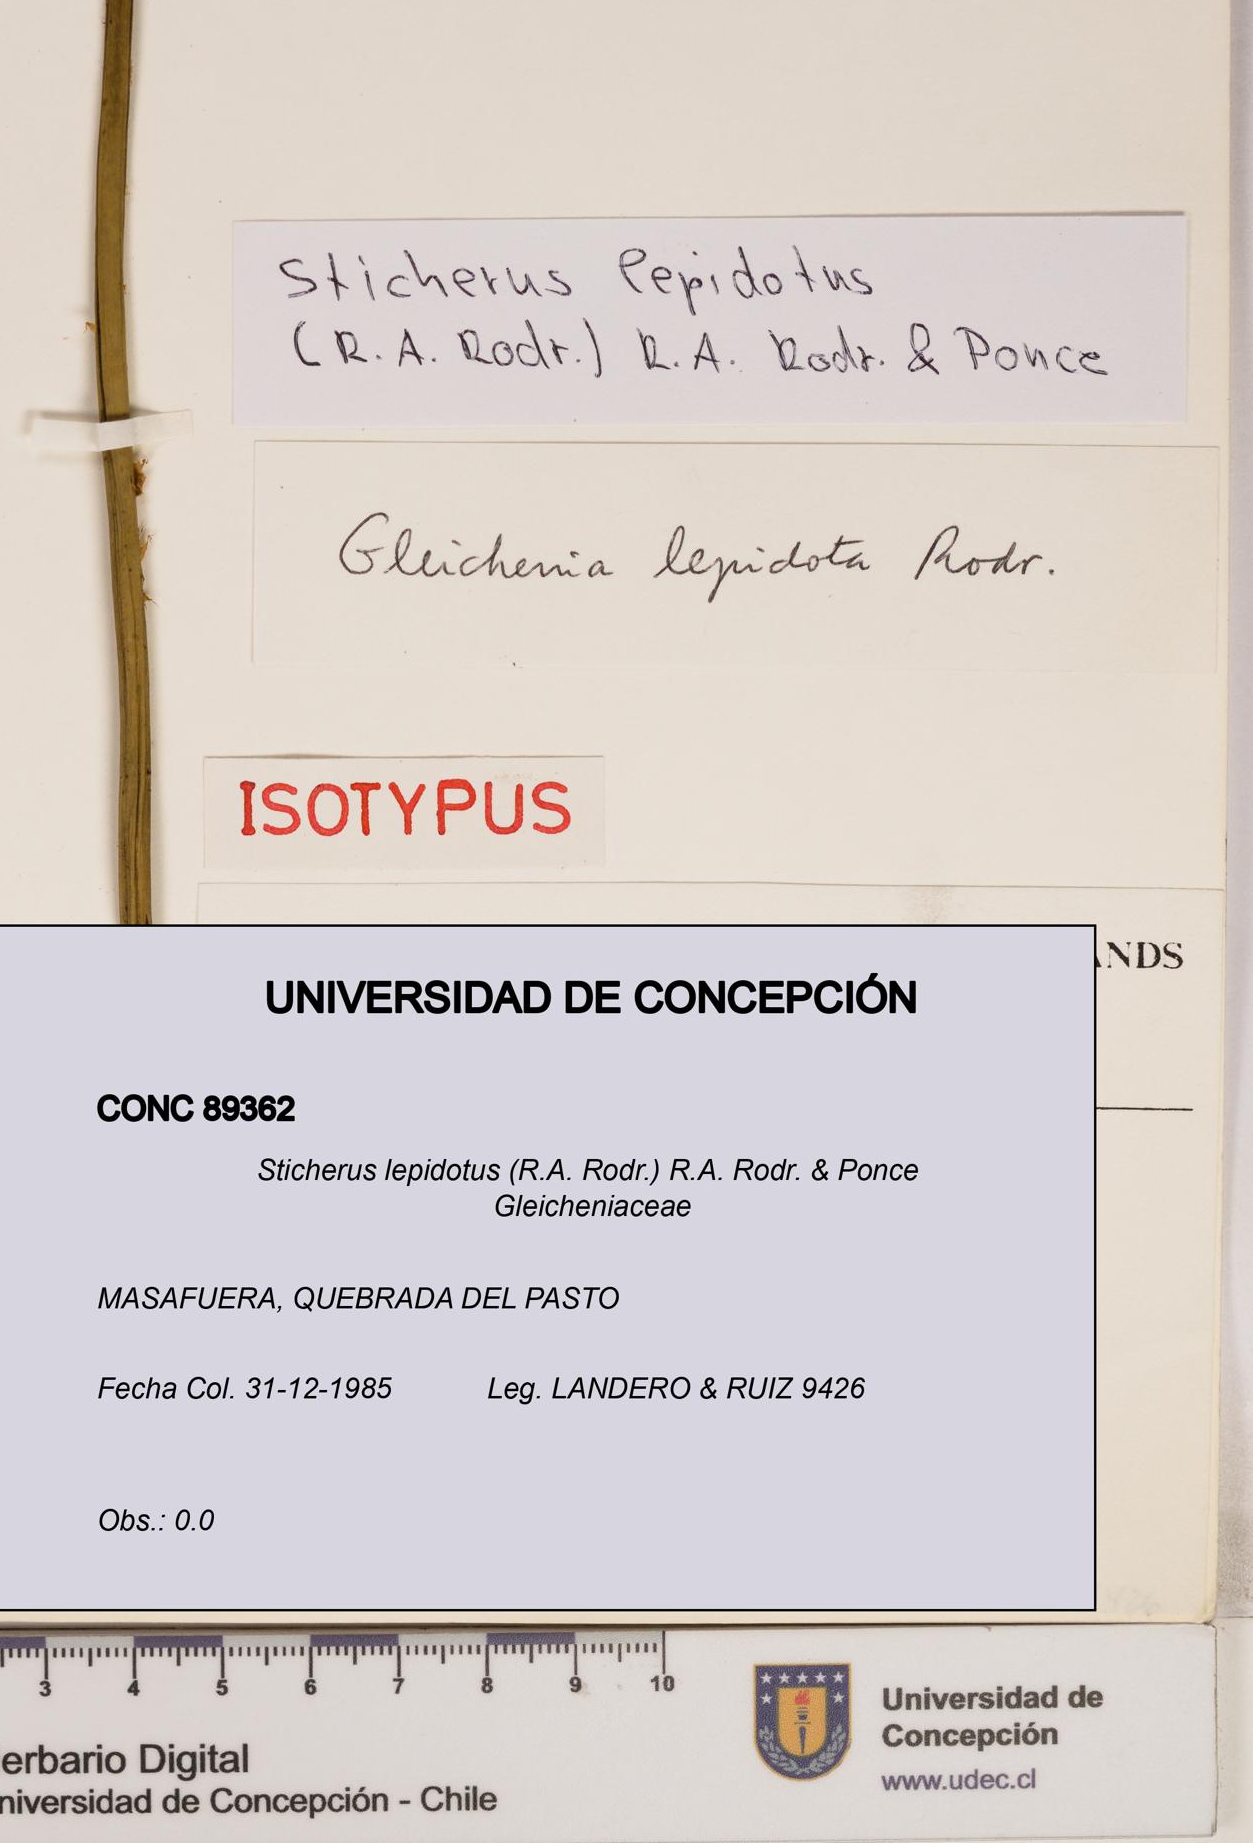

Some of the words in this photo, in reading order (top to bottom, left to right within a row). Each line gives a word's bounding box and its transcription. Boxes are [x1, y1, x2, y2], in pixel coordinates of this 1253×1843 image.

[279, 250, 573, 302] Sticherus
[907, 322, 940, 376] &
[953, 326, 1109, 376] Ponce
[339, 512, 615, 580] Gleichenia
[654, 525, 873, 604] lepidota
[915, 525, 1056, 581] Rodr.
[240, 779, 573, 838] ISOTYPUS
[1095, 941, 1185, 970] NDS
[40, 1681, 53, 1699] 3
[127, 1681, 142, 1698] 4
[216, 1680, 230, 1698] 5
[305, 1679, 318, 1697] 6
[393, 1679, 406, 1696] 7
[481, 1677, 495, 1695] 8
[570, 1677, 584, 1695] 9
[650, 1676, 676, 1693] 10
[882, 1684, 1060, 1712] Universidad
[1067, 1684, 1105, 1710] de
[881, 1722, 1060, 1754] Concepción
[139, 1743, 250, 1781] Digital
[881, 1768, 1038, 1793] www.udec.cl
[162, 1787, 202, 1815] de
[209, 1786, 390, 1819] Concepción
[420, 1785, 499, 1814] Chile
